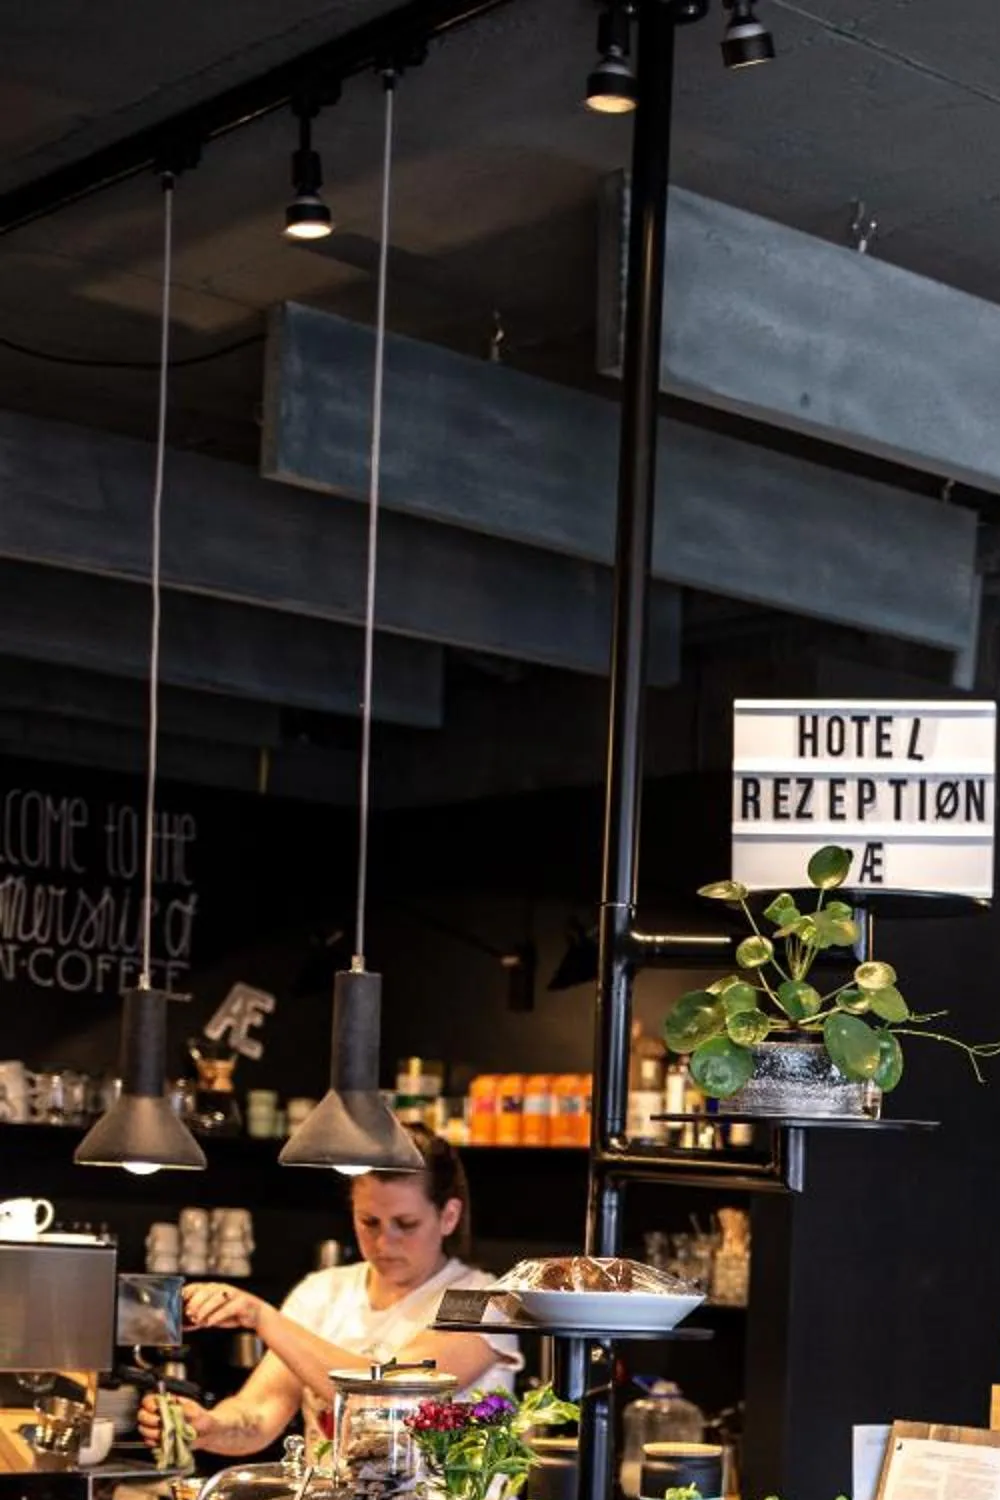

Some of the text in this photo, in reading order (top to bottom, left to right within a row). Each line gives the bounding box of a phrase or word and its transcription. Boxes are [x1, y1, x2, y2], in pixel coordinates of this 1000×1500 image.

[799, 714, 925, 762] HOTEL
[741, 776, 986, 823] REZEPTIØN
[858, 841, 884, 884] Æ
